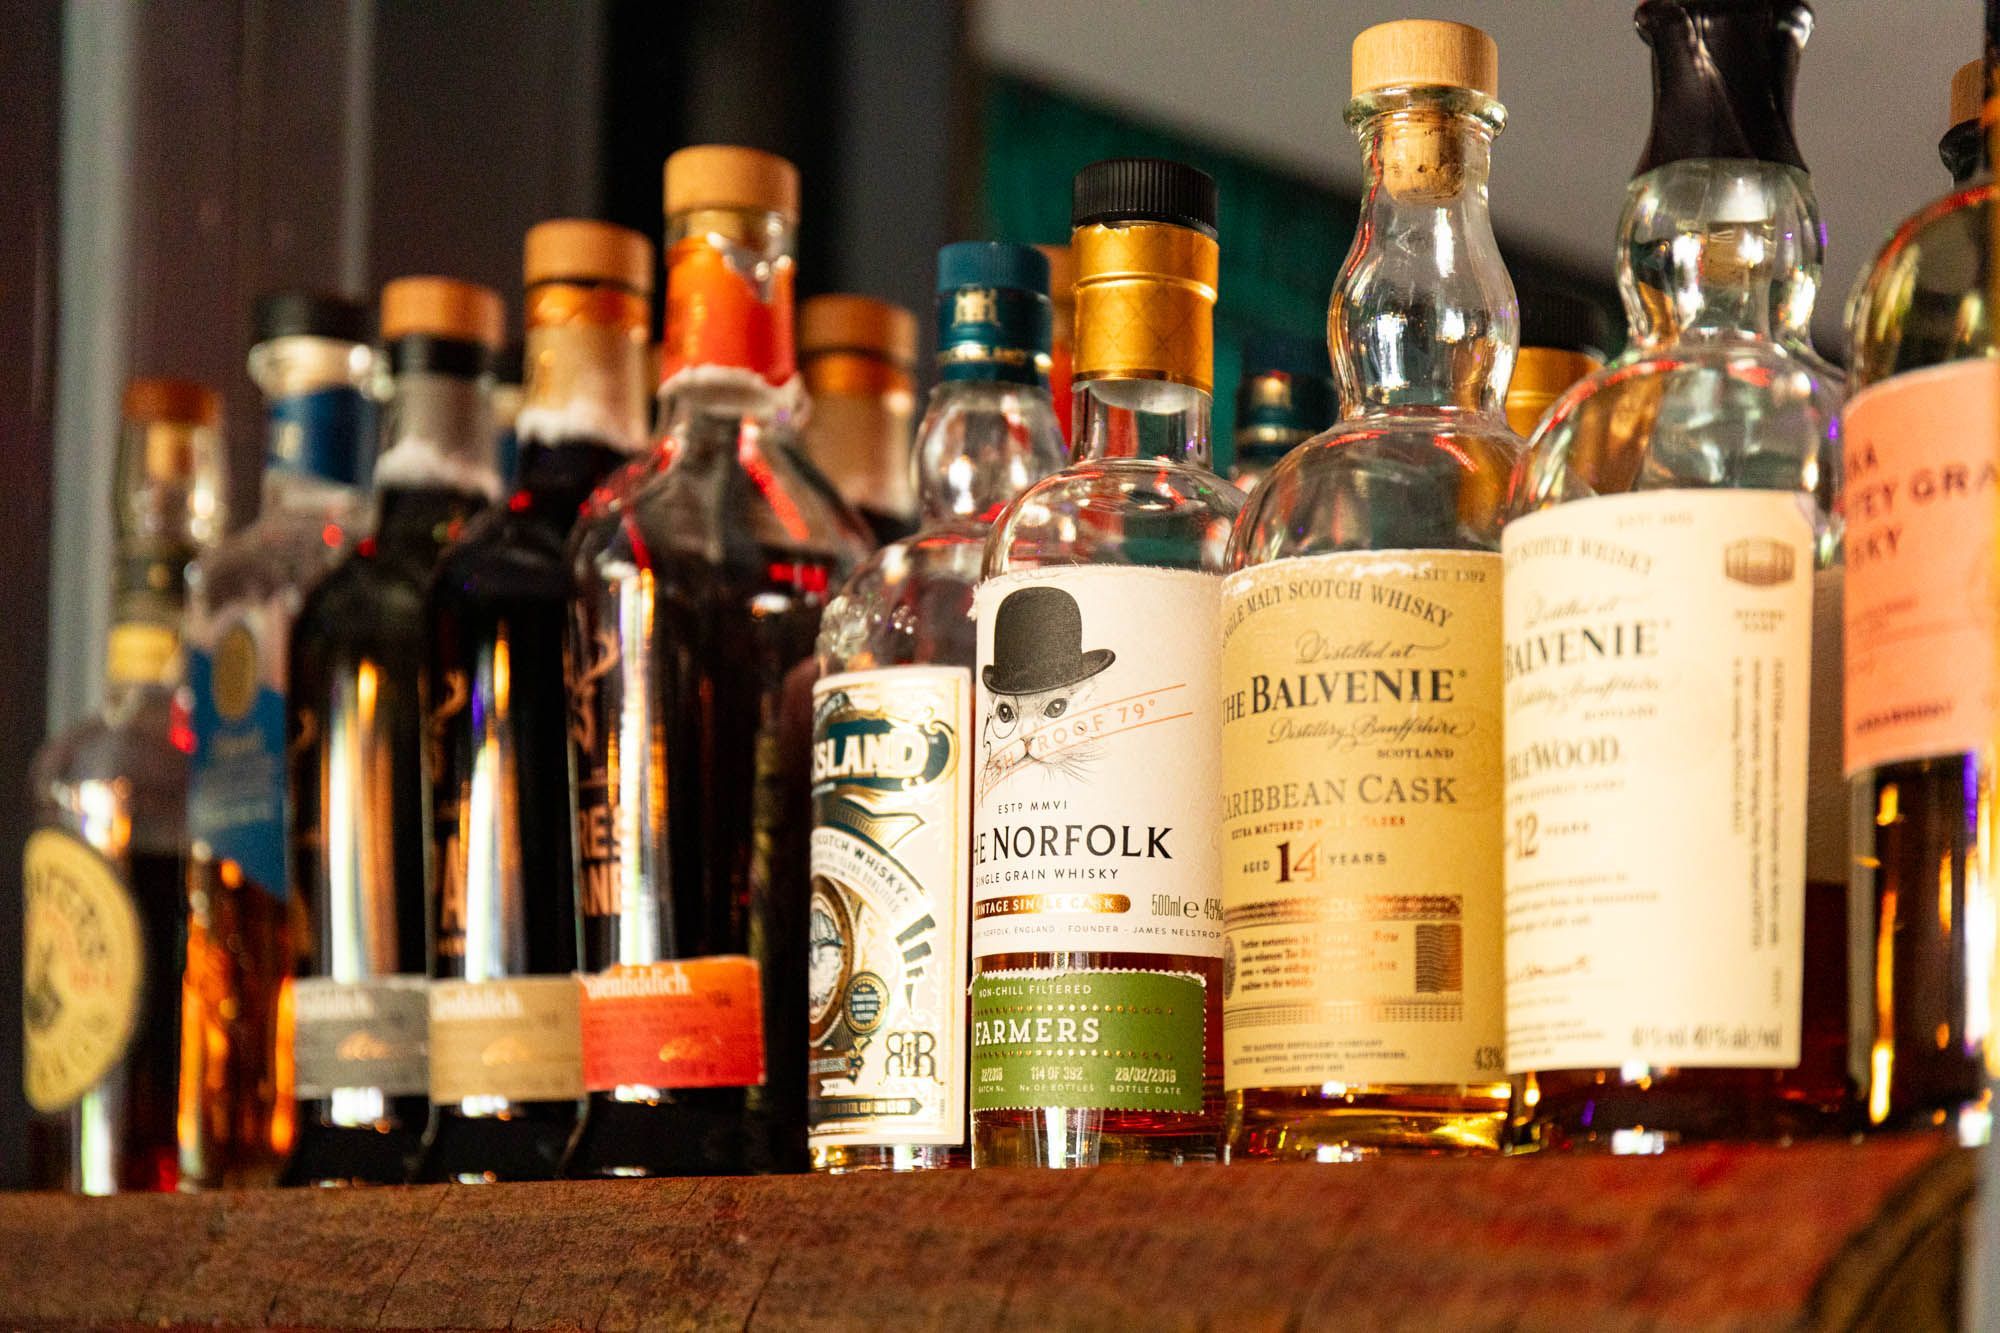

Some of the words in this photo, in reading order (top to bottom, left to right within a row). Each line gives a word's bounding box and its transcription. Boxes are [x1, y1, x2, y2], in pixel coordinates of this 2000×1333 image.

[1246, 585, 1283, 614] MALT
[1288, 579, 1363, 601] SCOTCH
[1371, 584, 1454, 628] WHISKY
[1295, 631, 1392, 665] Distilled
[1223, 691, 1246, 727] THE
[1251, 669, 1456, 715] BALVENIE
[1377, 748, 1455, 760] SCOTLAND
[1357, 774, 1458, 805] CASK
[1030, 800, 1067, 811] MMVI
[993, 824, 1173, 860] NORFOLK
[854, 847, 907, 895] WHISKY
[1005, 868, 1046, 882] GRAIN
[1054, 867, 1119, 880] WHISKY
[1243, 860, 1271, 874] AGED
[1276, 839, 1322, 883] 14
[1328, 851, 1388, 866] YEARS
[1151, 893, 1181, 917] 500ml
[1014, 924, 1055, 934] ENGLAND
[1068, 924, 1119, 933] FOUNDER
[1133, 926, 1167, 935] JAMES
[1171, 928, 1222, 939] NELSTROP
[1029, 984, 1092, 995] FILTERED
[975, 1016, 1099, 1046] FARMERS
[1051, 1082, 1095, 1092] BOTTLES
[1109, 1083, 1151, 1094] BOTTLE
[1155, 1085, 1182, 1095] DATE
